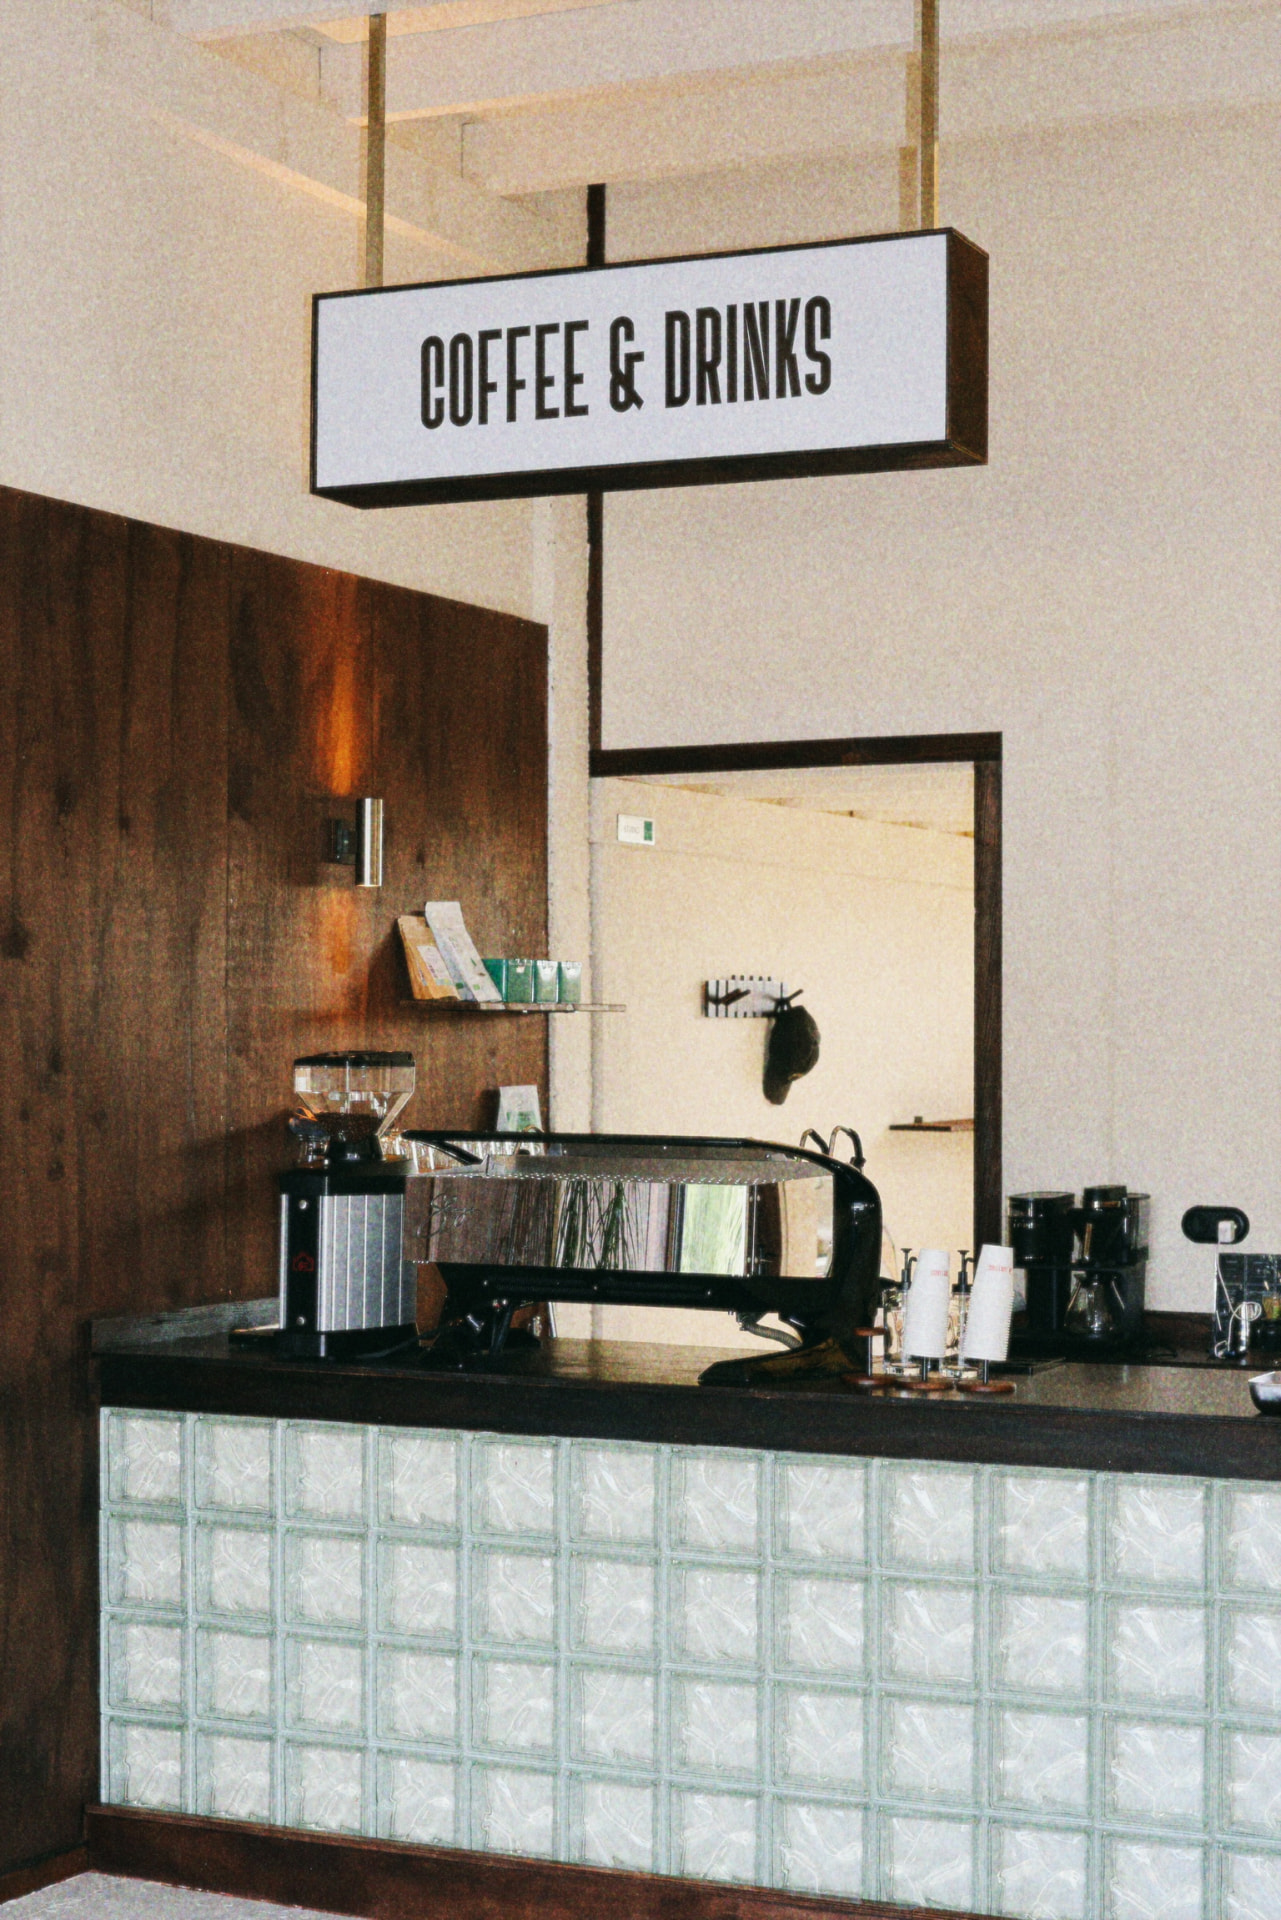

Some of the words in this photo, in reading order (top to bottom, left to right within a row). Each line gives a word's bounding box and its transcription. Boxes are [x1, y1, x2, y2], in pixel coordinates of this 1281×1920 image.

[420, 319, 589, 430] COFFEE
[608, 315, 646, 414] &
[664, 294, 832, 409] DRINKS
